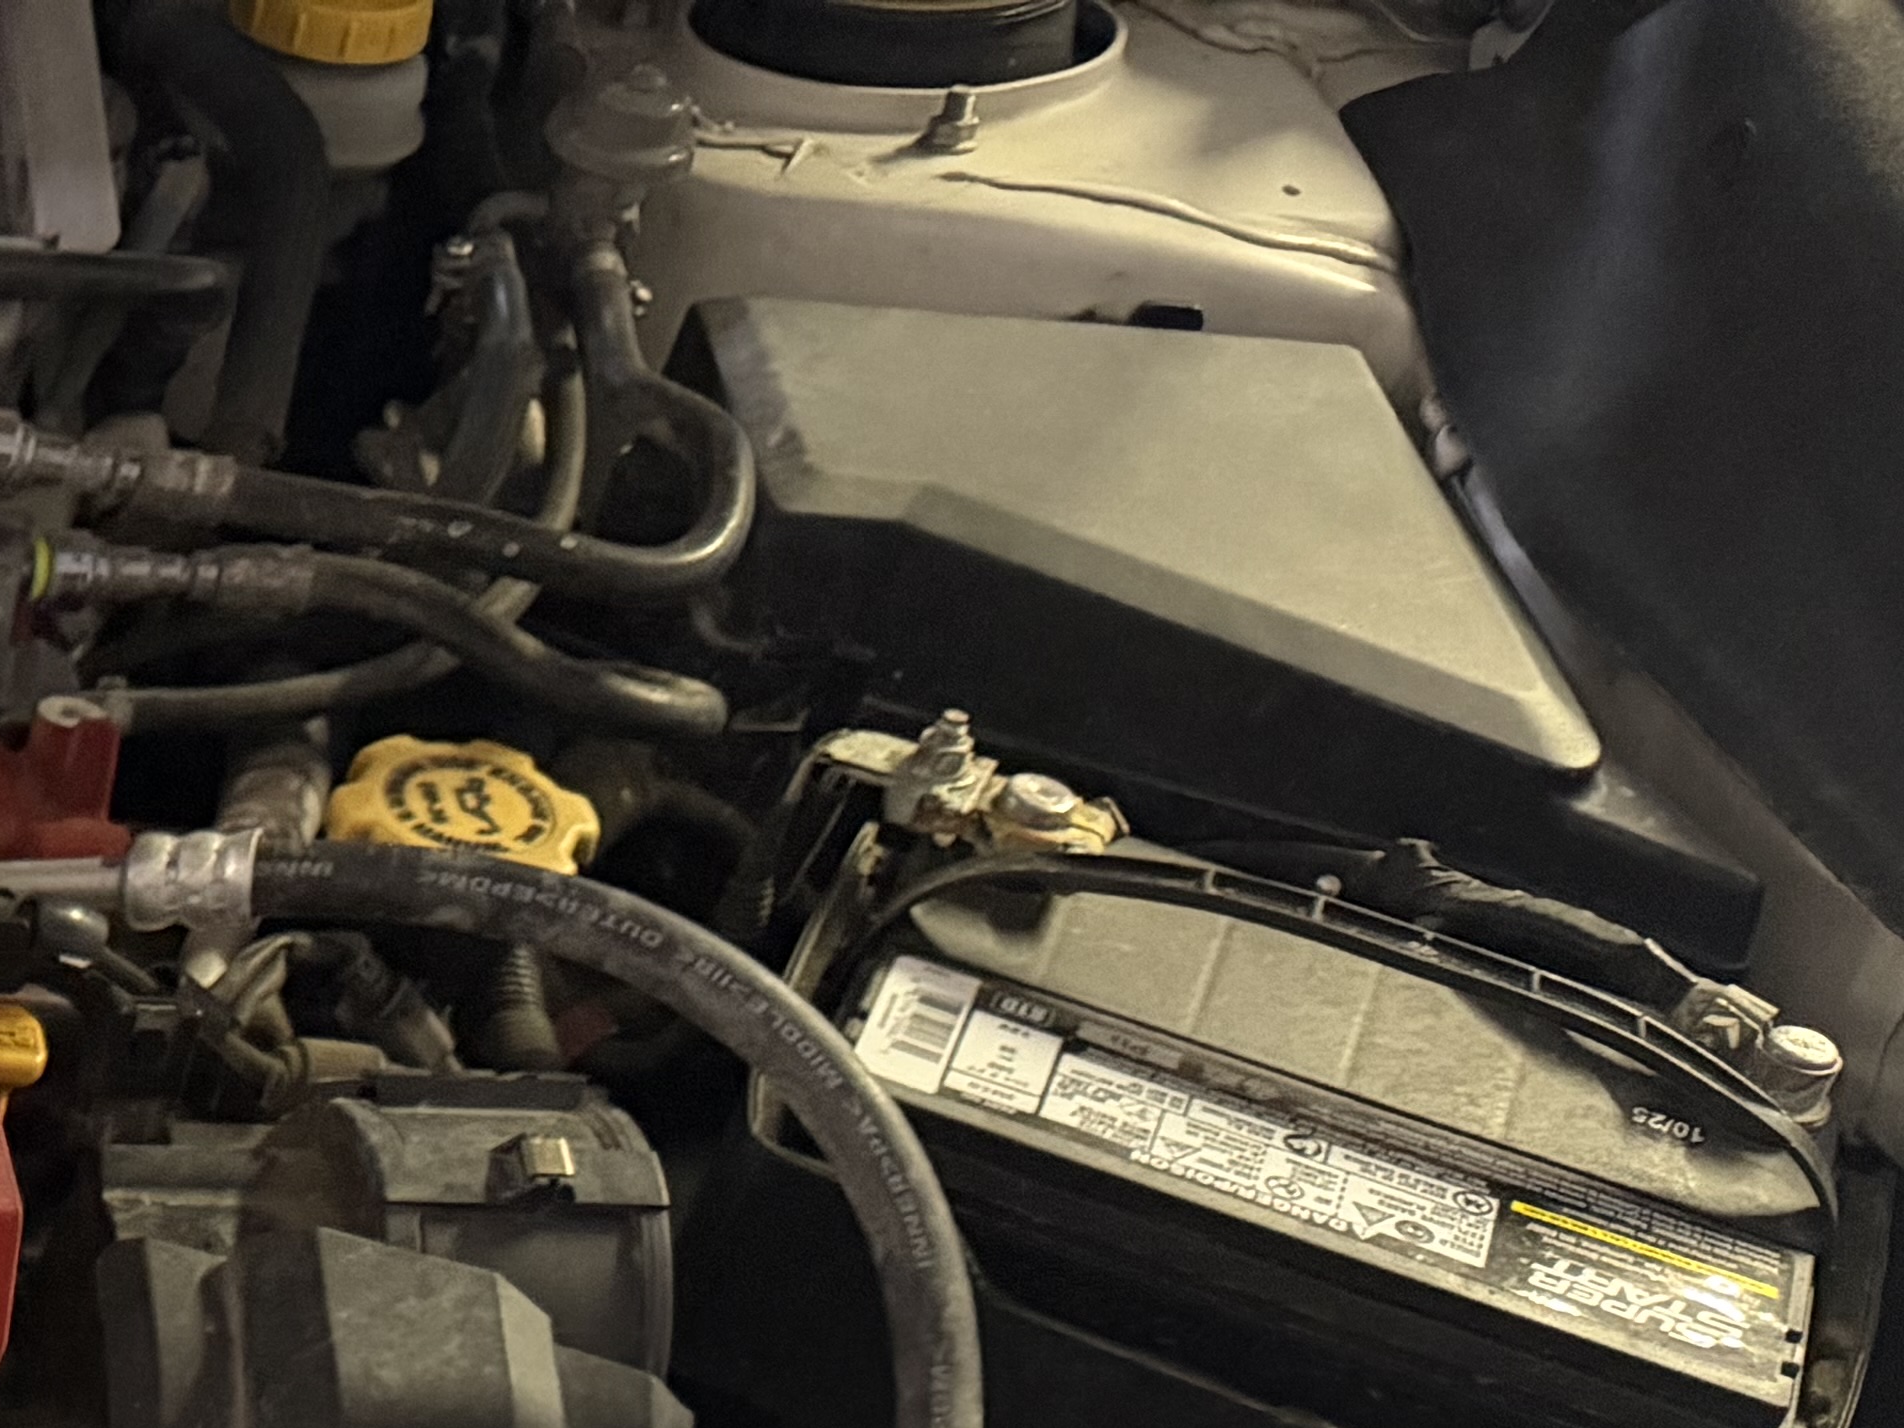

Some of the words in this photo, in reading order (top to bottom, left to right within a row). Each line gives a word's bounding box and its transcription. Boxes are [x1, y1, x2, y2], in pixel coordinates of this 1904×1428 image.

[1632, 1106, 1706, 1143] 10/25
[1528, 1271, 1719, 1349] SUPER
[1531, 1258, 1751, 1340] START
